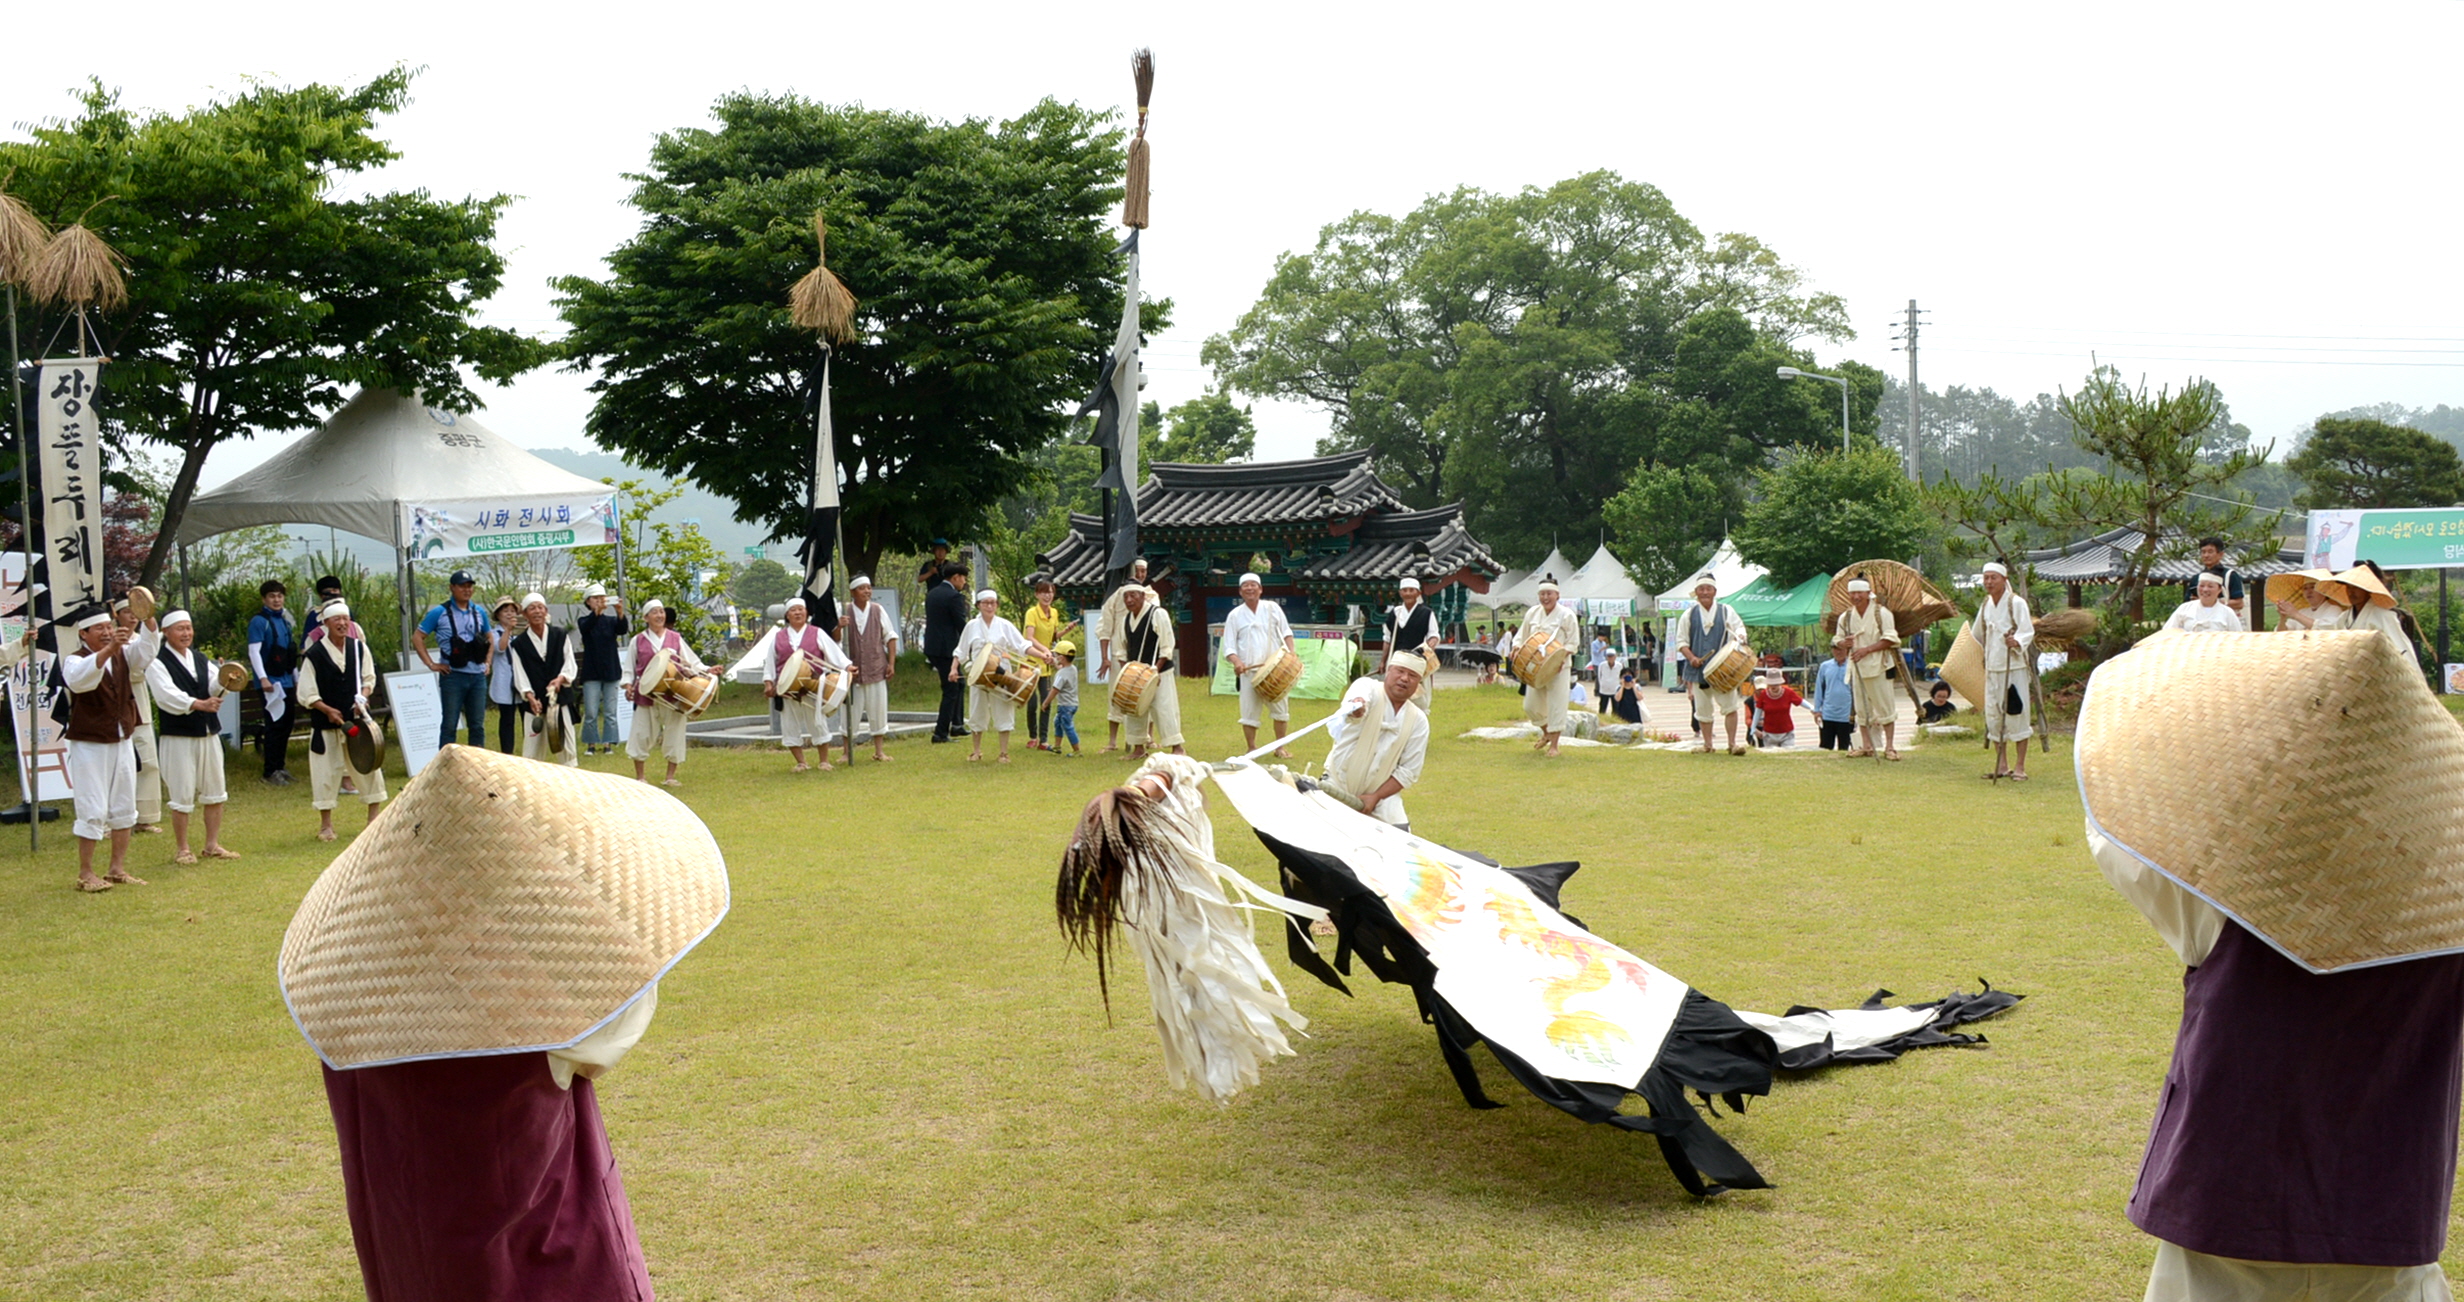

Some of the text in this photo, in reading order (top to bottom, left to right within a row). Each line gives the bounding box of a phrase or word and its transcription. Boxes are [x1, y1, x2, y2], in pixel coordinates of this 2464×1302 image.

[438, 433, 486, 448] 증평군
[474, 509, 510, 530] 시화
[518, 505, 571, 528] 전시회
[472, 534, 536, 550] (사)한국문인협회
